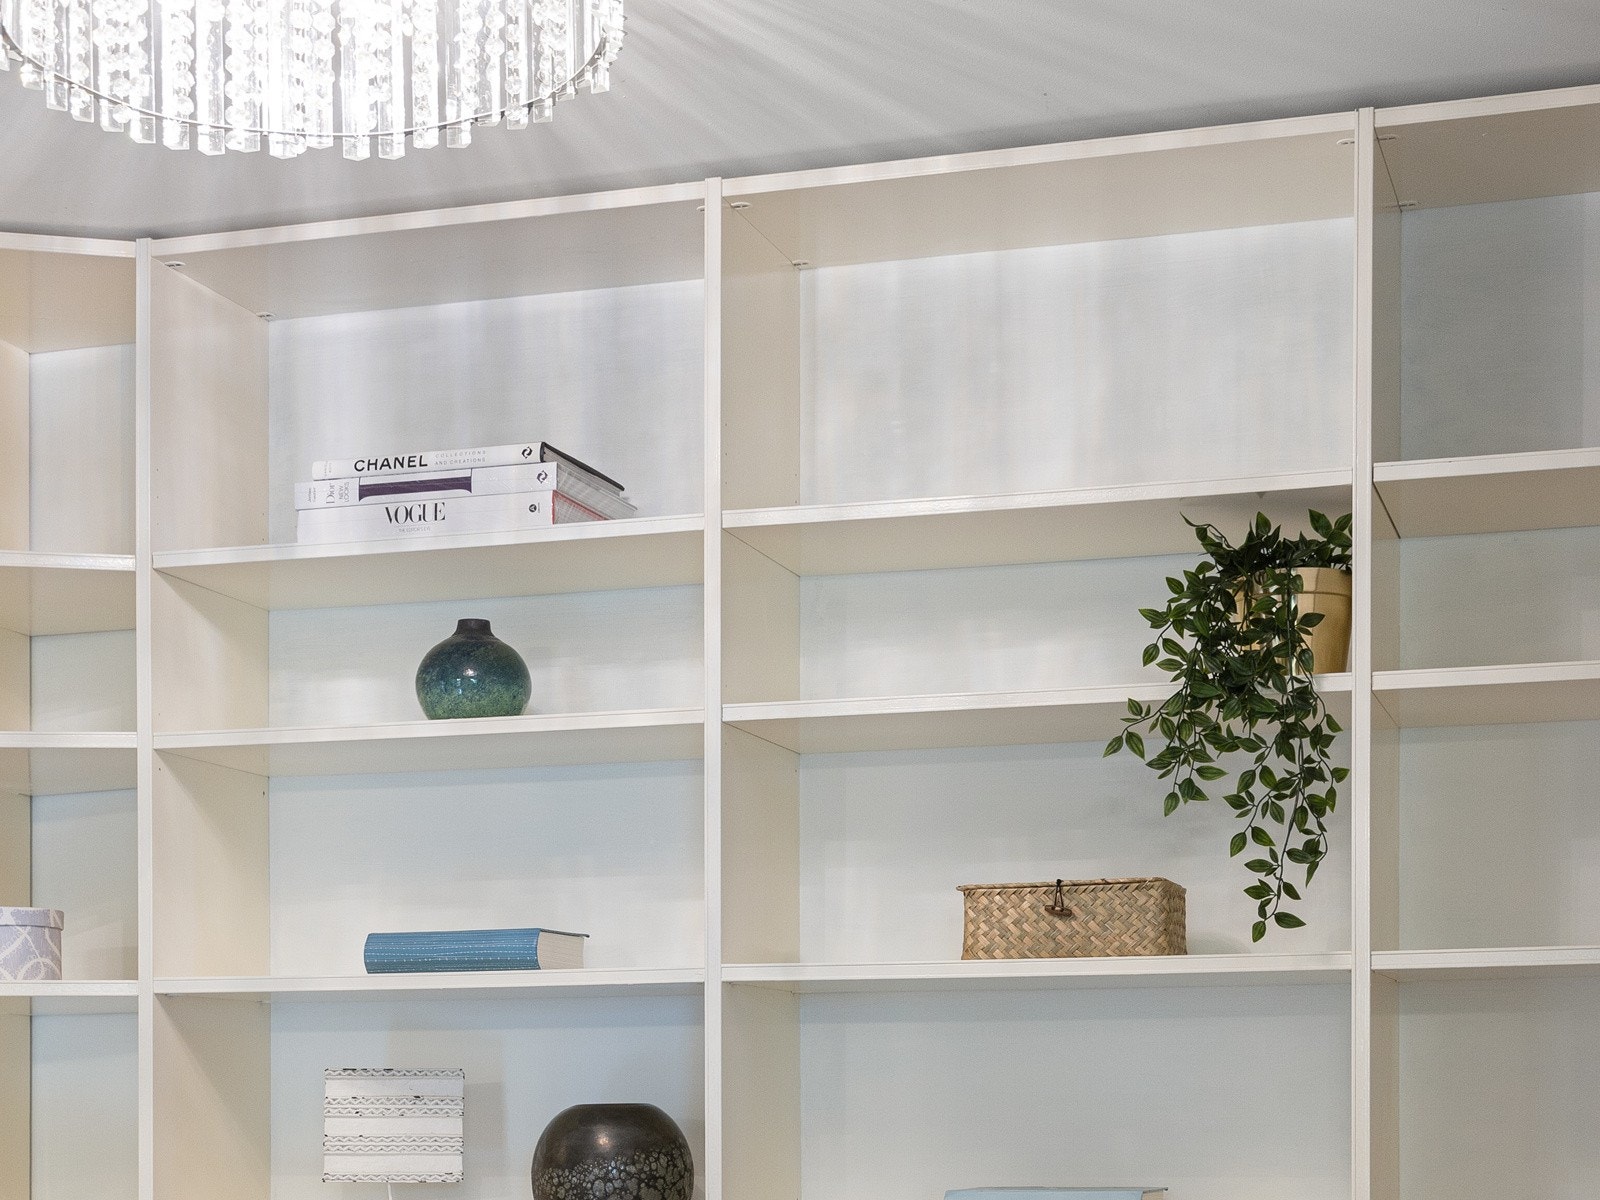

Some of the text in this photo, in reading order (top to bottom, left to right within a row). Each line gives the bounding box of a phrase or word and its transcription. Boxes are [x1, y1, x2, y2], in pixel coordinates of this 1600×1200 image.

[435, 450, 486, 458] COLLECTIONS
[449, 457, 486, 465] CREATIONS
[354, 455, 428, 472] CHANEL
[326, 483, 335, 504] Dior
[384, 502, 446, 524] VOGUE
